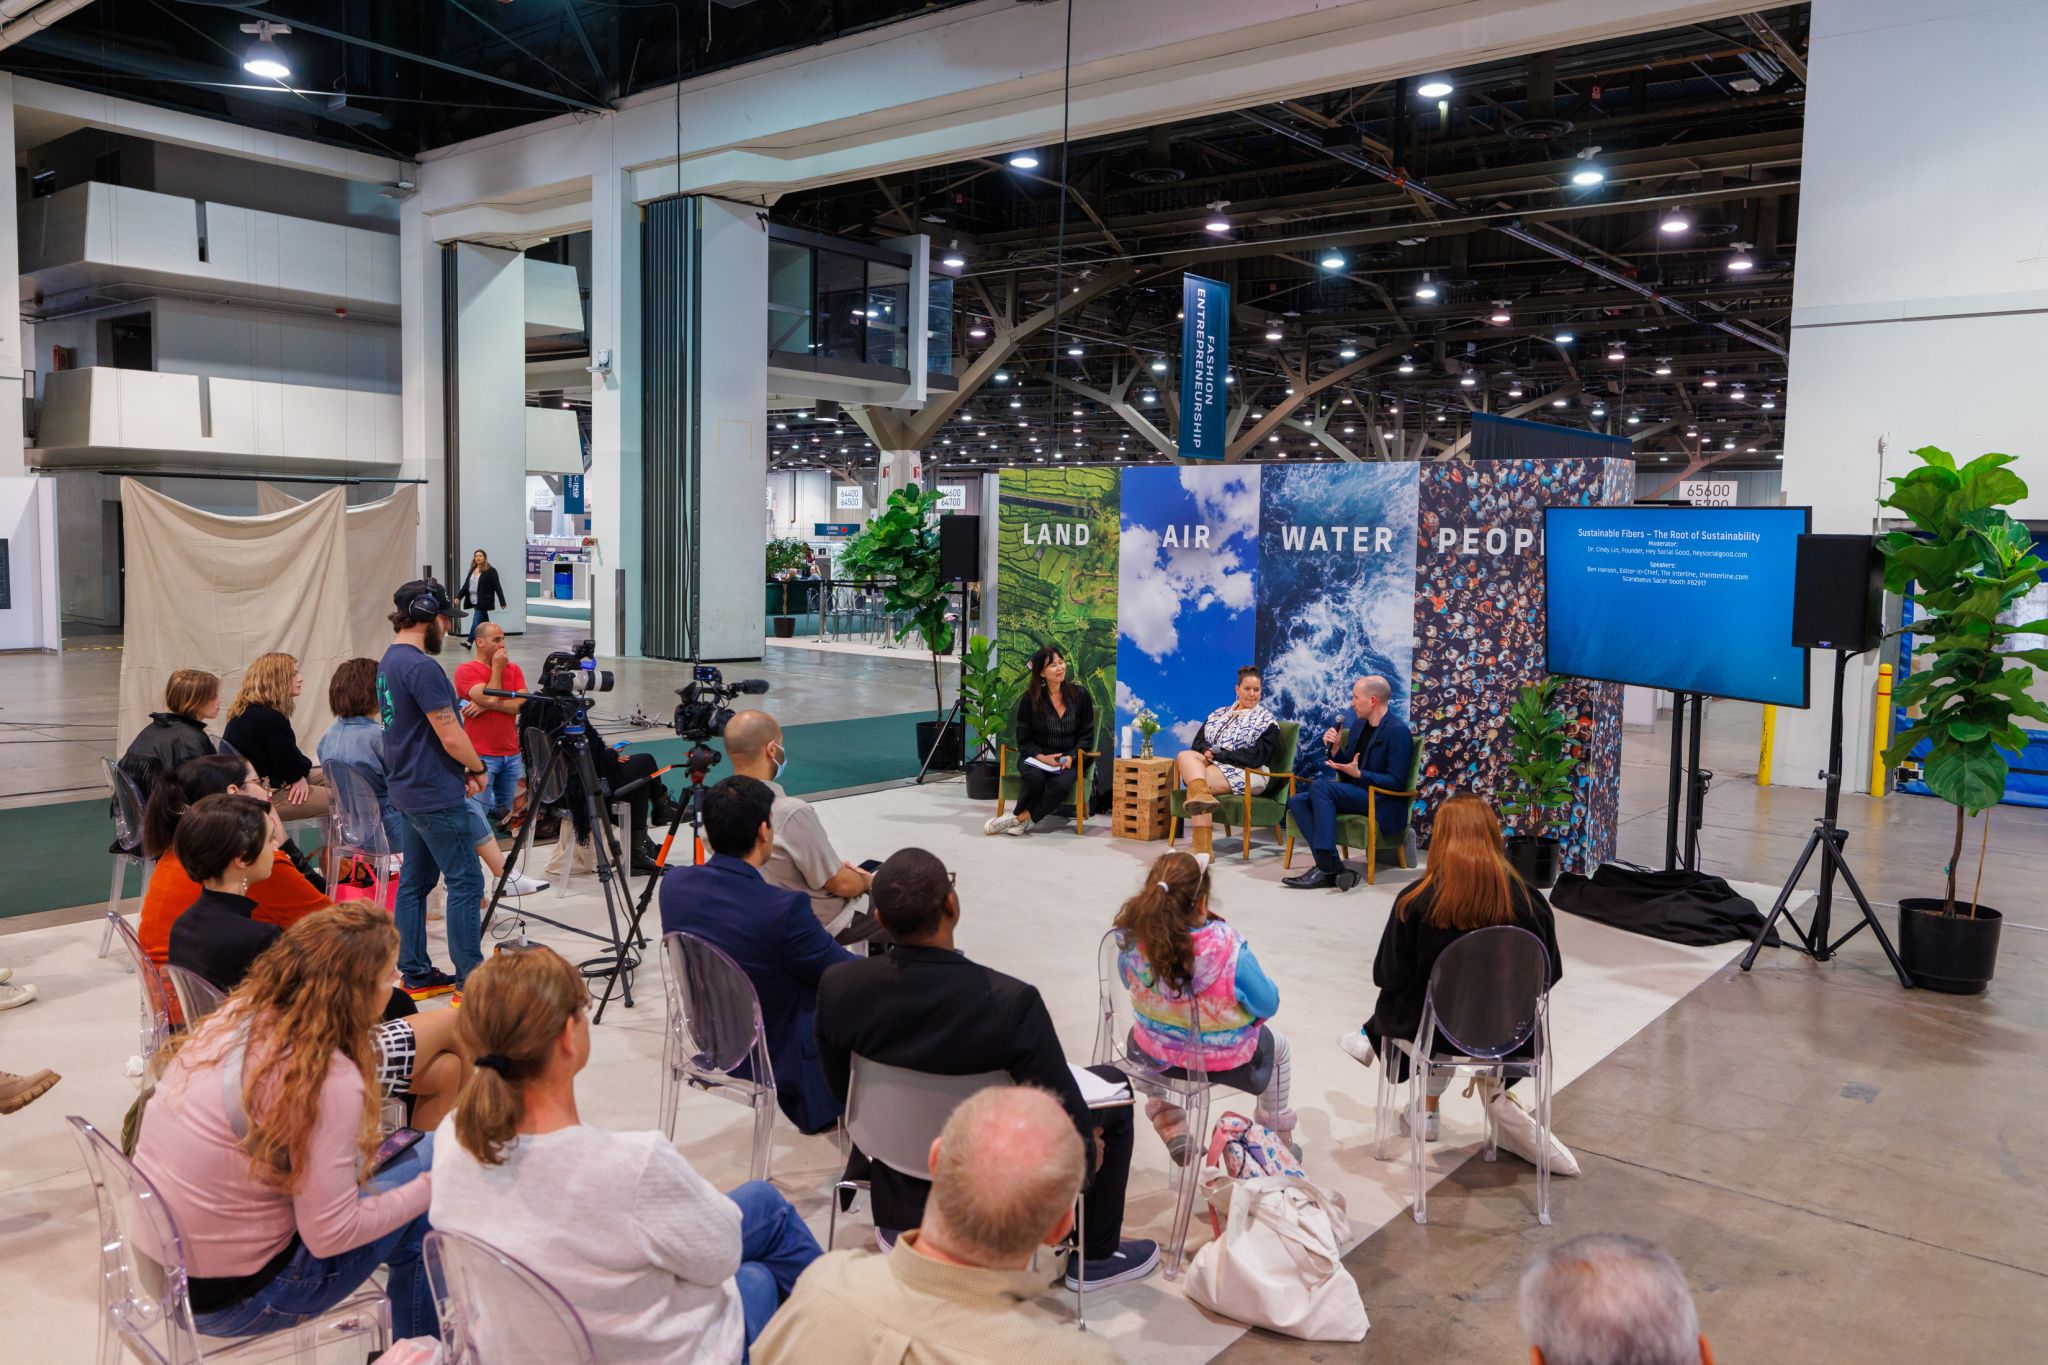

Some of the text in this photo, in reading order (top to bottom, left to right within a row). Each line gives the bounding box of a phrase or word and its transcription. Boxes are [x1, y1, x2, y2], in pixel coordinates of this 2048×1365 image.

[1193, 288, 1206, 448] ENTREPRENEURSHIP
[1205, 335, 1215, 405] FASHION
[840, 489, 859, 498] 64400
[1687, 484, 1730, 497] 65600
[840, 498, 859, 506] 64500
[941, 498, 961, 507] 64700
[1023, 523, 1090, 546] LAND
[1162, 524, 1210, 548] AIR
[1281, 526, 1393, 553] WATER
[1578, 528, 1620, 538] Sustainable
[1621, 529, 1645, 538] Fibers
[1653, 529, 1668, 539] The
[1670, 530, 1689, 539] Root
[1690, 531, 1700, 540] of
[1701, 531, 1761, 543] Sustainability
[1595, 546, 1610, 554] Cindy
[1611, 547, 1620, 555] Lin,
[1621, 547, 1645, 555] Founder,
[1645, 548, 1656, 556] Hey
[1657, 548, 1673, 556] Social
[1674, 549, 1691, 557] Good,
[1692, 550, 1748, 558] heysocialgood.com
[1649, 561, 1677, 569] Speakers:
[1598, 566, 1618, 574] Hanson,
[1619, 567, 1660, 576] Editor-in-Chief,
[1661, 569, 1671, 577] The
[1699, 572, 1749, 580] theinterline.com
